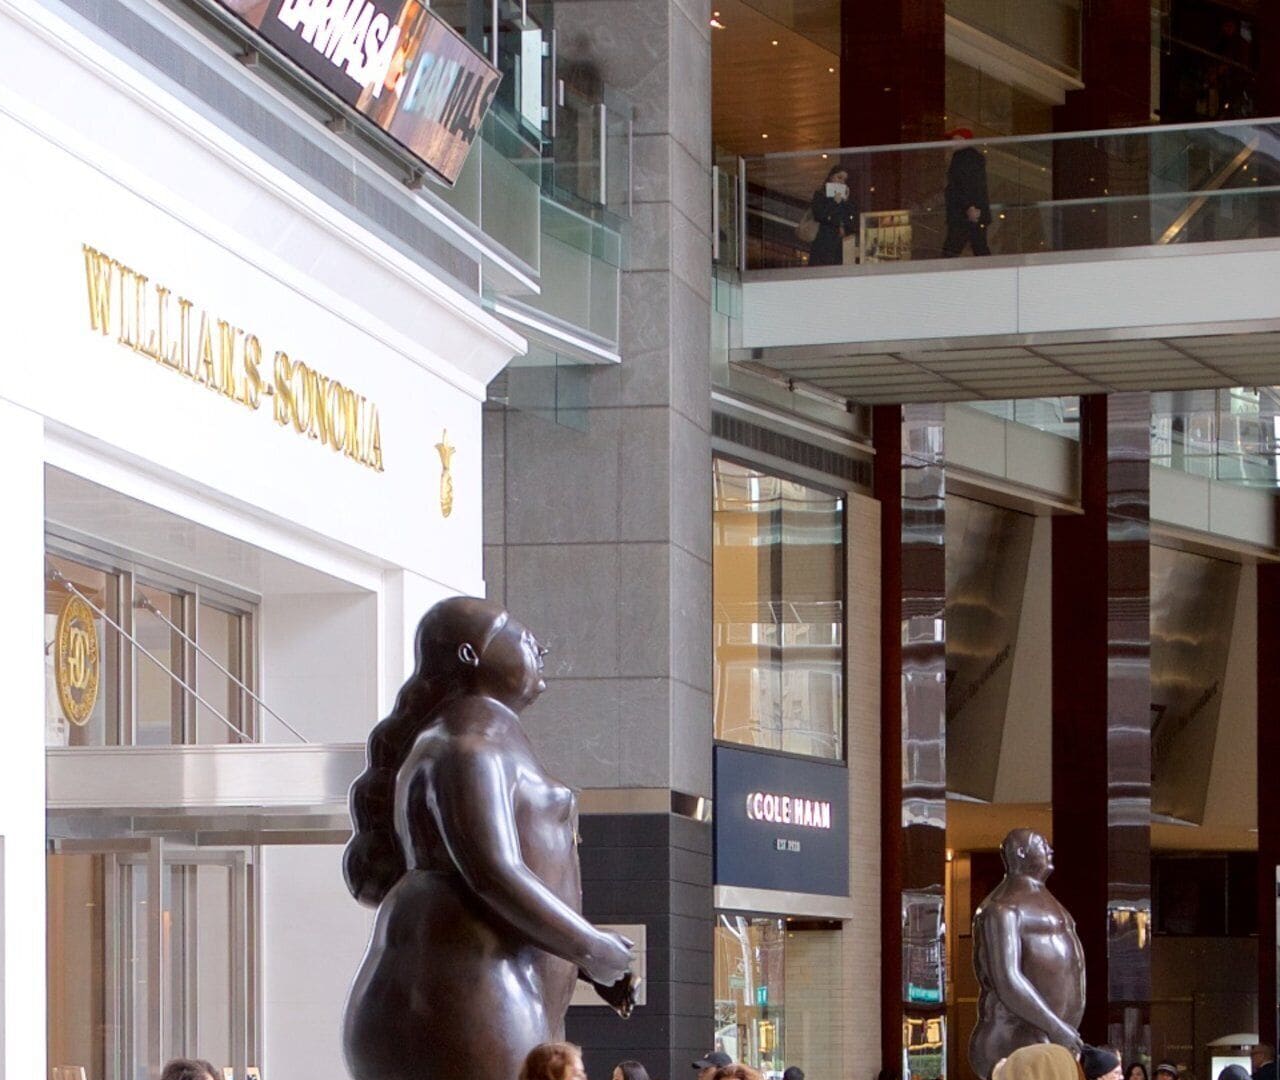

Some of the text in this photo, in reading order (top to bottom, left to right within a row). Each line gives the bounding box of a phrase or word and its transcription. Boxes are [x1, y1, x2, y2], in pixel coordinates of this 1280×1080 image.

[82, 243, 385, 473] WILLIAMS-SONOMA
[753, 792, 830, 829] COLE HAAN
